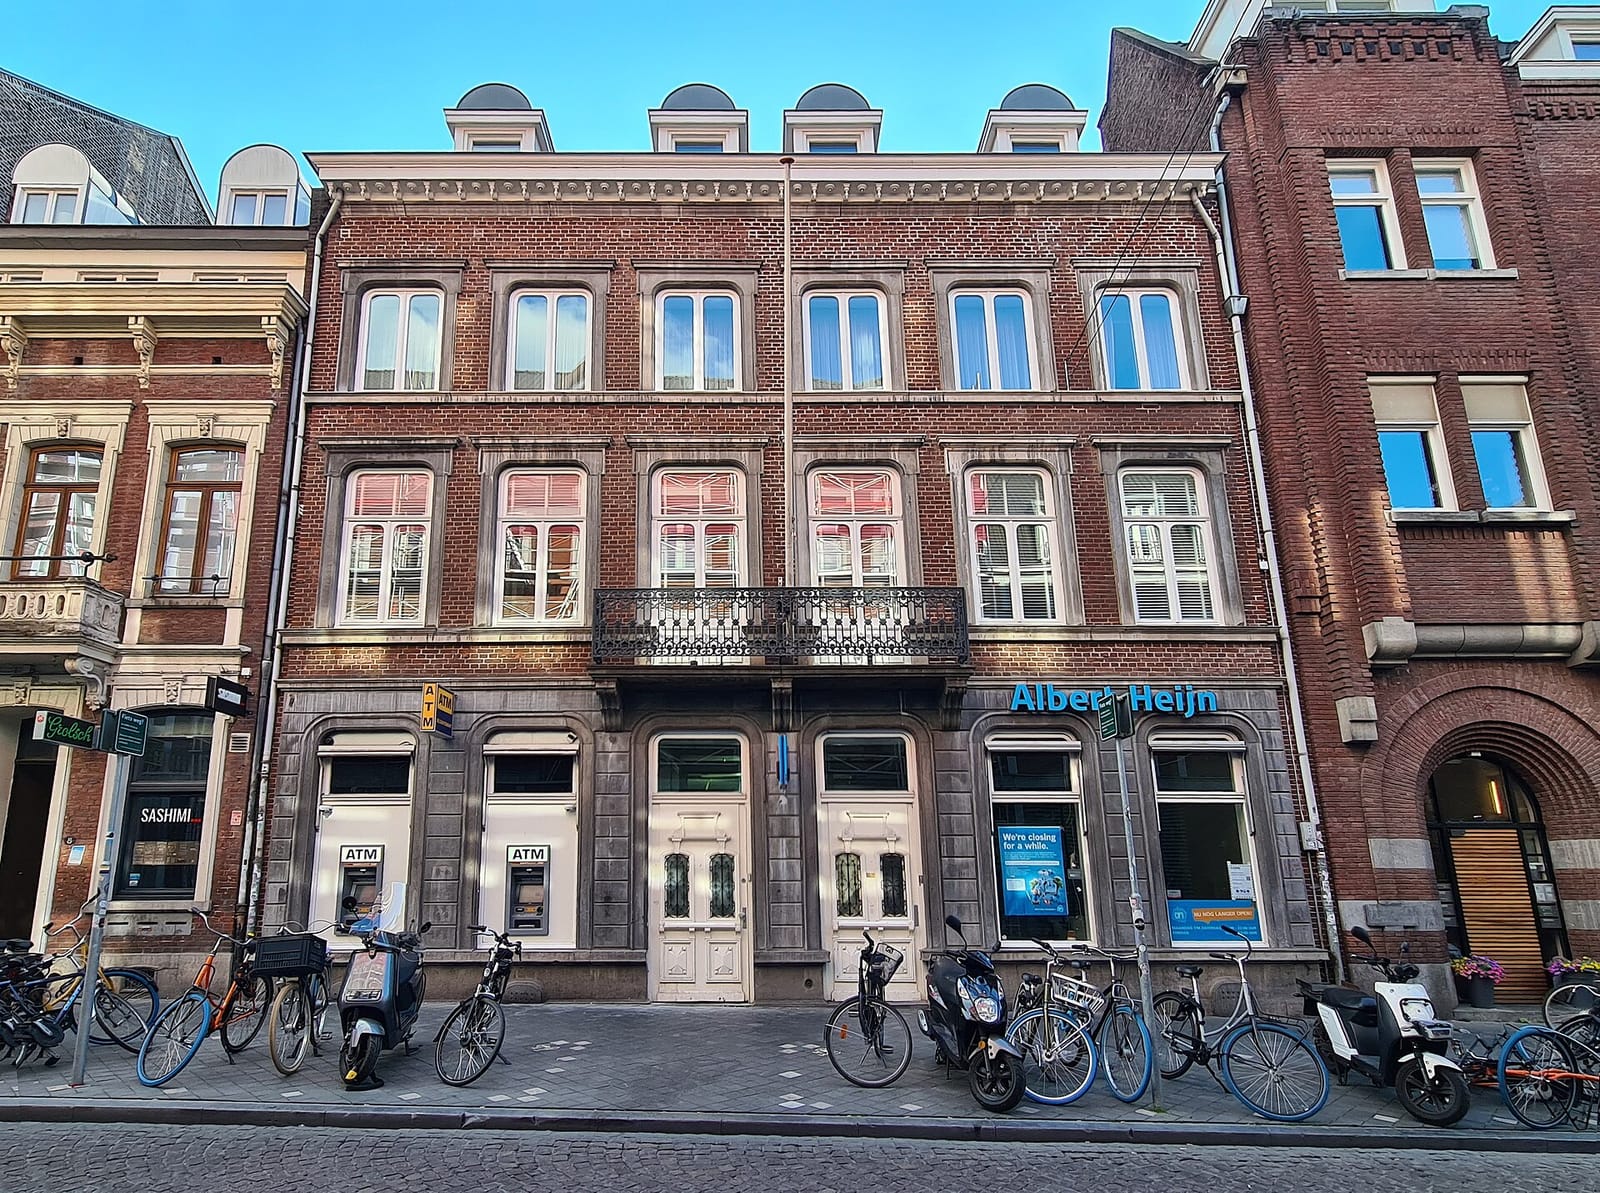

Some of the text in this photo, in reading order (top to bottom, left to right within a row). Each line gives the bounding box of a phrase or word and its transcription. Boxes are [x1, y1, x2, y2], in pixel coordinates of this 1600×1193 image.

[423, 686, 434, 727] ATM
[439, 693, 452, 710] ATM
[1129, 685, 1218, 718] Heijn
[47, 716, 94, 742] Grolsch
[1003, 833, 1057, 843] We're closing
[1003, 842, 1015, 850] for
[1024, 842, 1049, 850] while.
[345, 849, 377, 860] ATM
[512, 849, 544, 860] ATM
